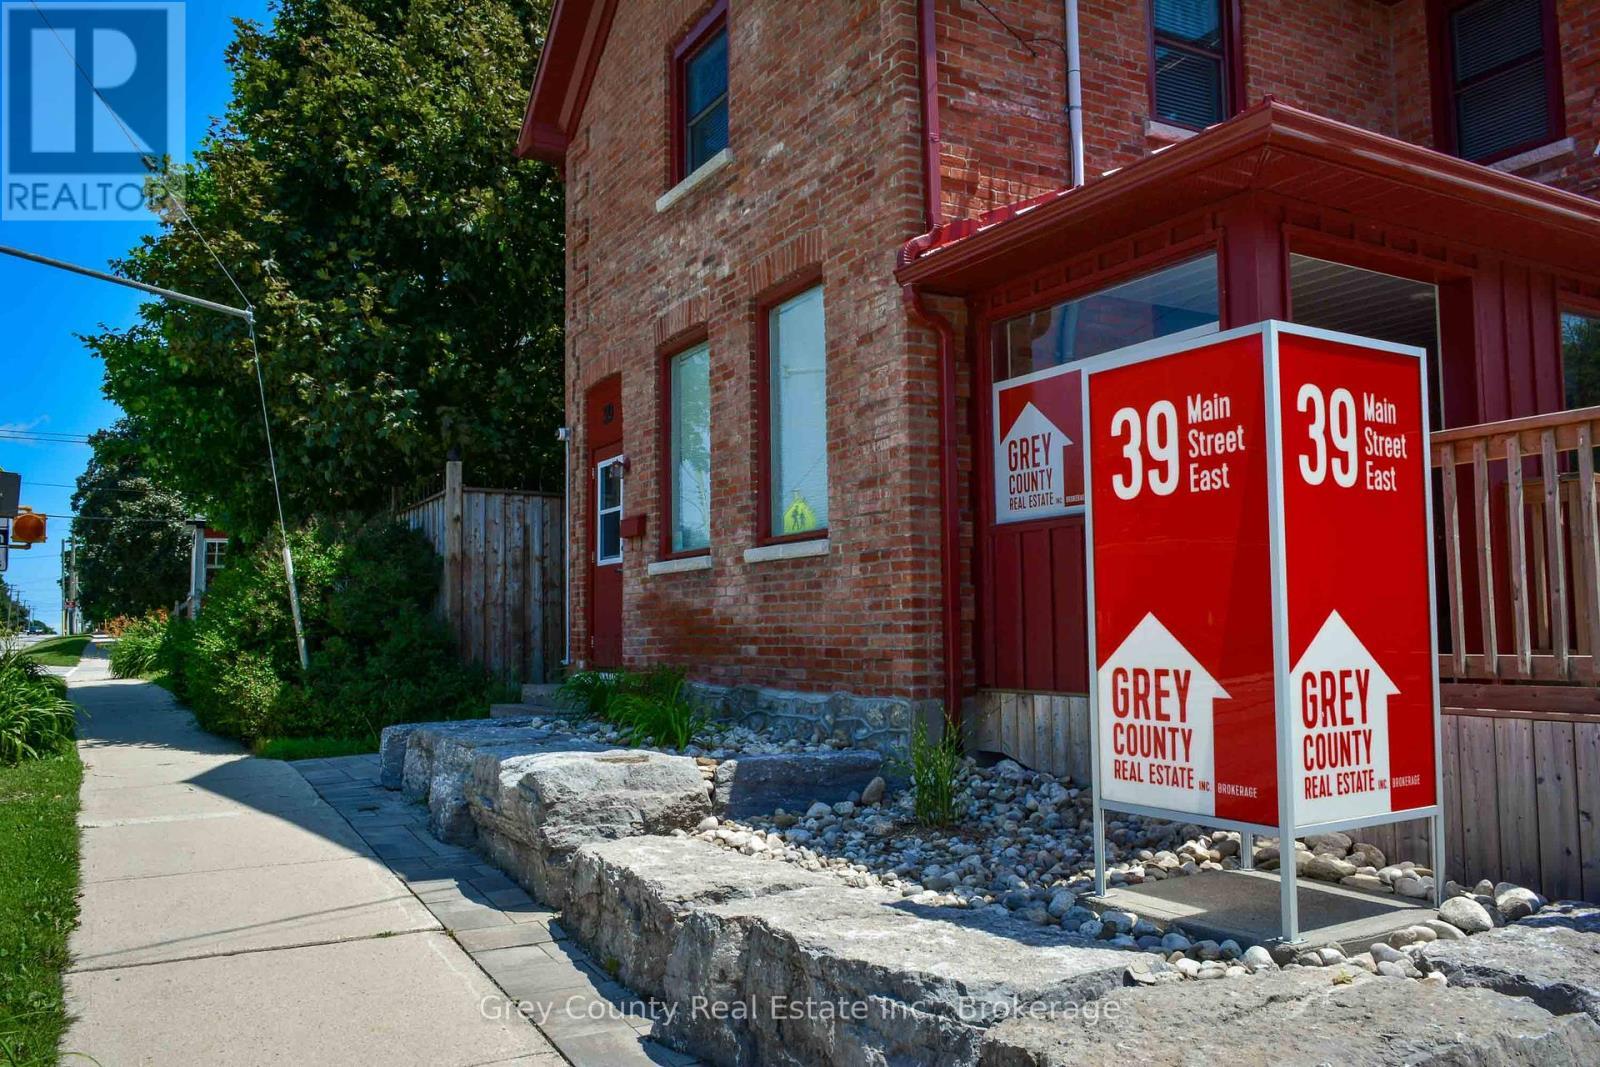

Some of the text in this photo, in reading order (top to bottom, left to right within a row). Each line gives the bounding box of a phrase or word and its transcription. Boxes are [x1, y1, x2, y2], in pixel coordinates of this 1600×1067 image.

[1186, 392, 1231, 424] Main
[1363, 391, 1397, 425] Main
[1008, 432, 1052, 472] GREY
[1110, 399, 1180, 501] 39
[1187, 424, 1246, 458] Street
[1296, 383, 1358, 488] 39
[1364, 426, 1407, 459] Street
[1008, 468, 1053, 495] COUNTY
[1189, 462, 1230, 492] East
[1365, 460, 1398, 492] East
[1009, 496, 1027, 511] REAL
[1028, 492, 1054, 508] ESTATE
[1111, 666, 1192, 723] GREY
[1301, 668, 1370, 729] GREY
[1113, 722, 1192, 762] COUNTY
[1303, 729, 1372, 772] COUNTY
[1114, 759, 1144, 783] REAL
[1149, 763, 1194, 790] ESTATE
[1217, 782, 1258, 799] BROKERAGE
[1304, 775, 1333, 800] REAL
[1336, 769, 1375, 795] ESTATE
